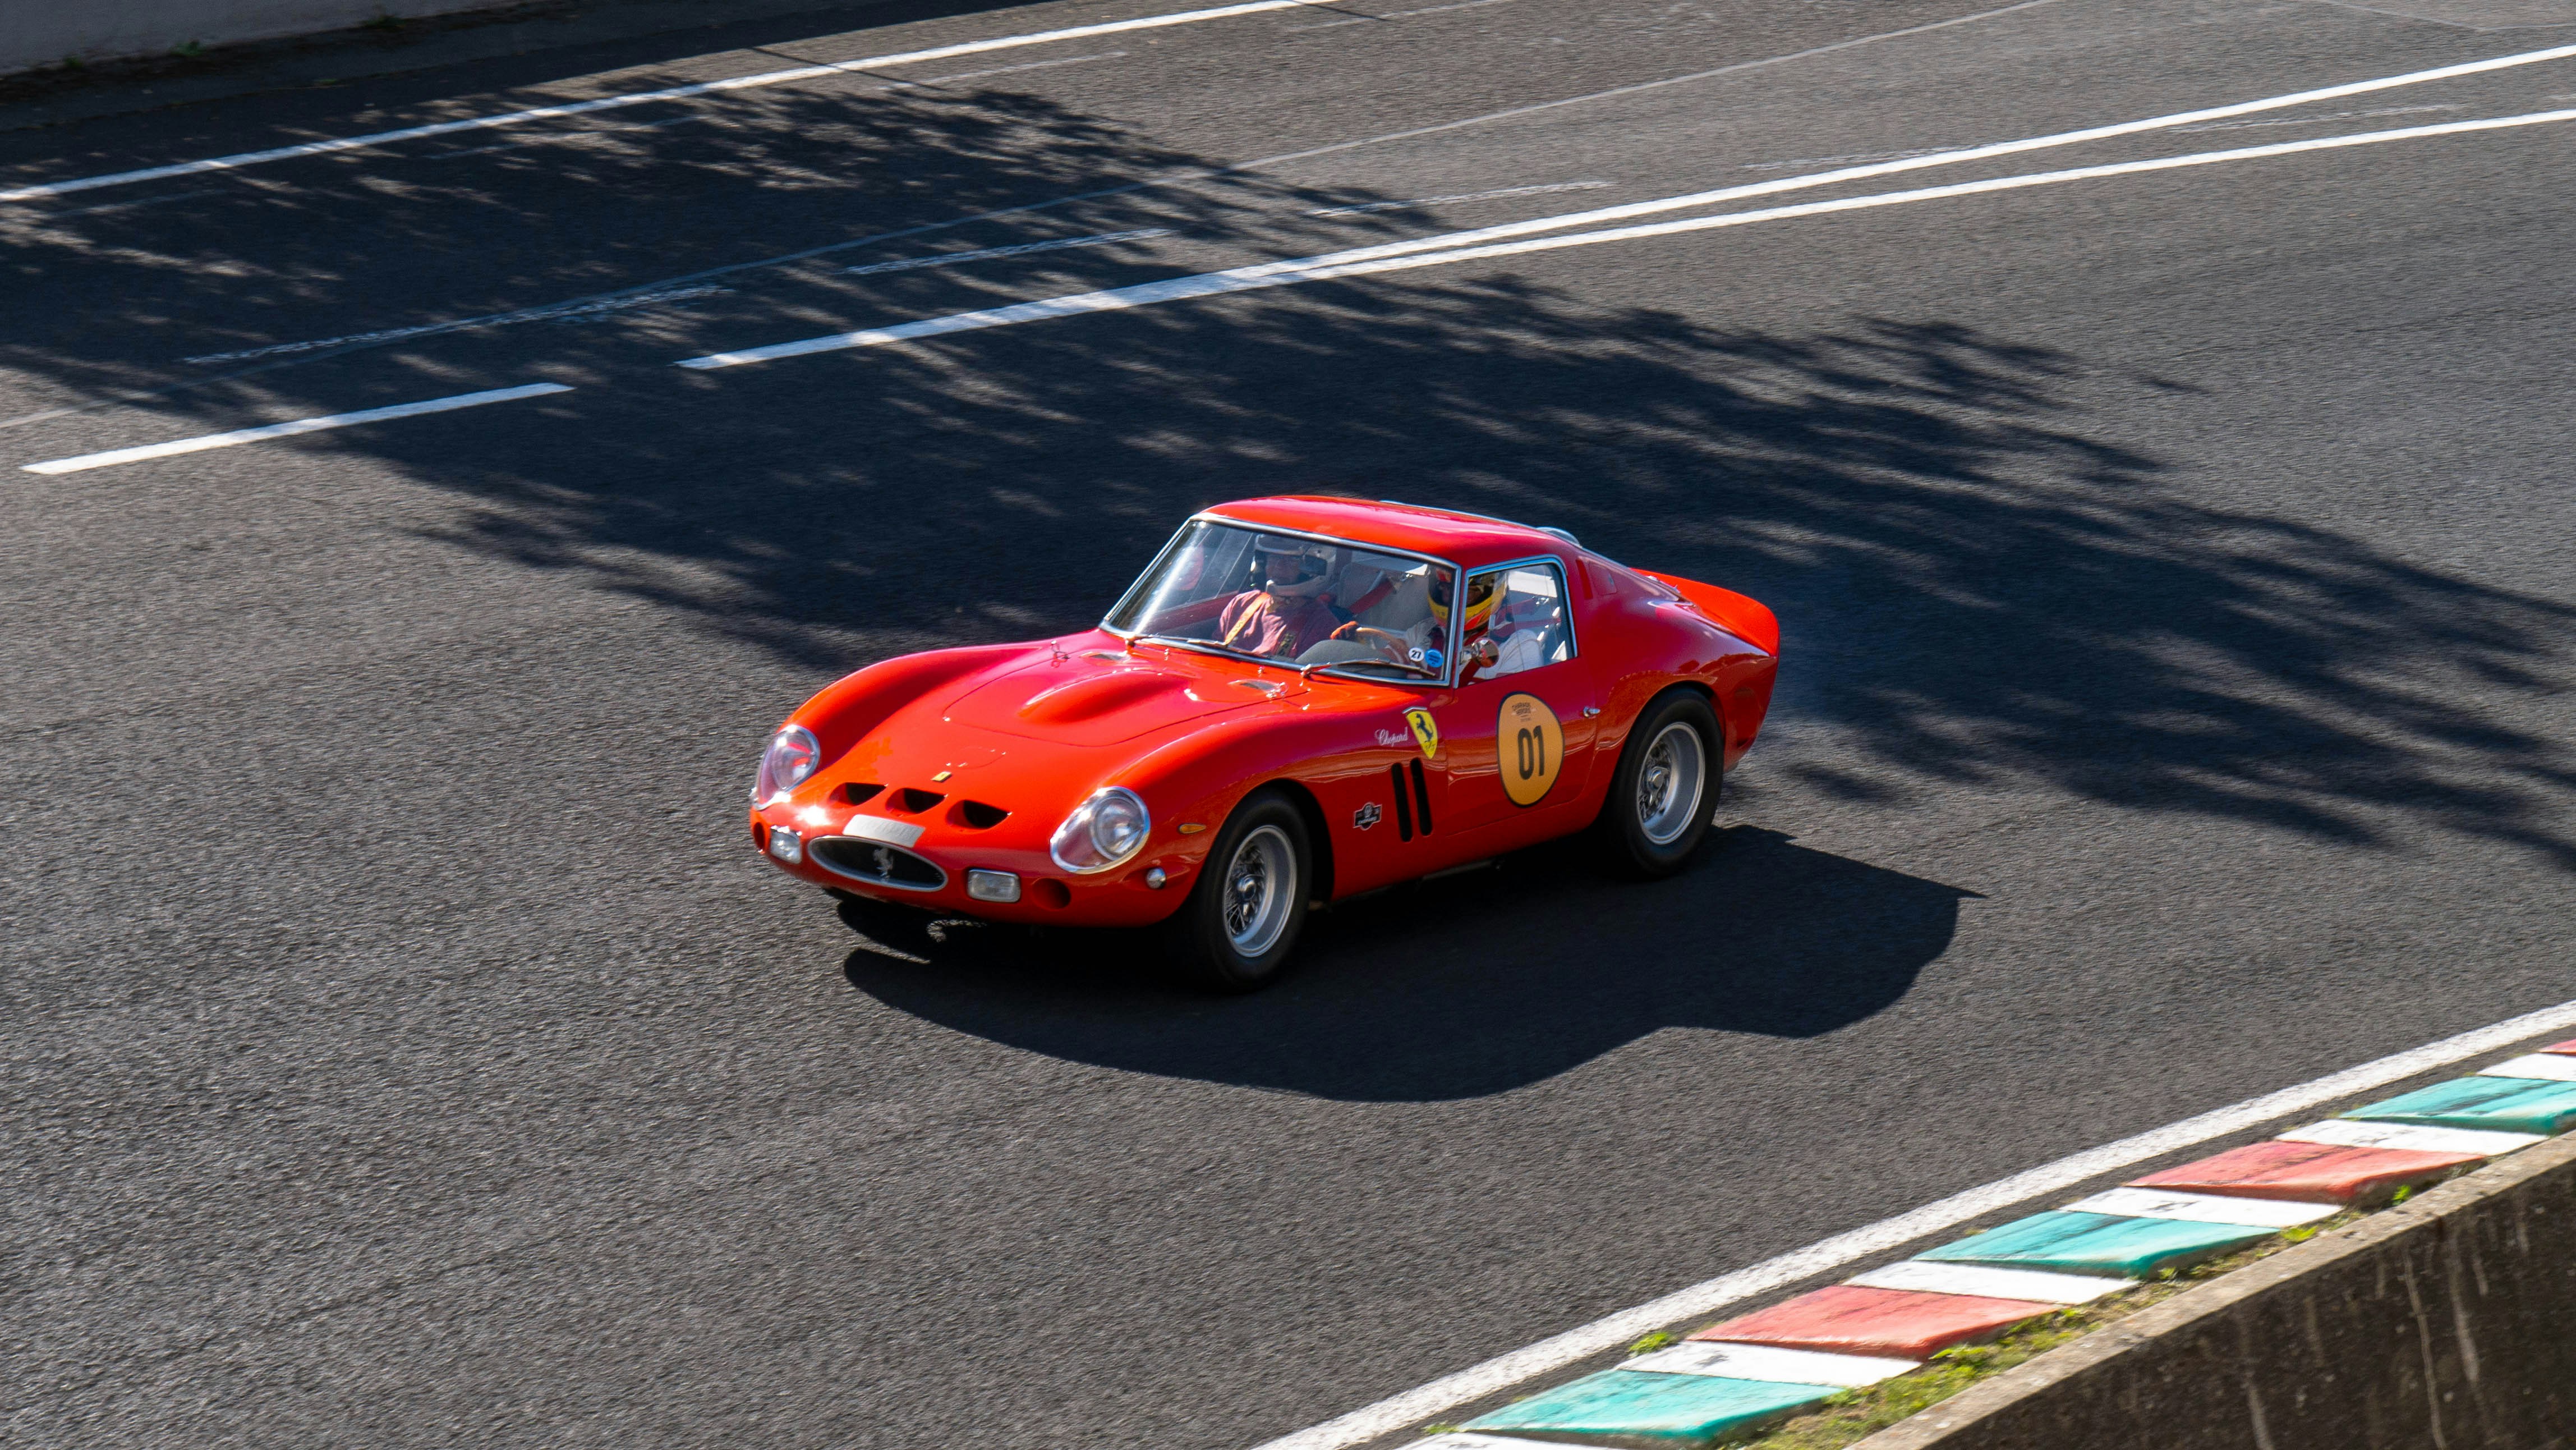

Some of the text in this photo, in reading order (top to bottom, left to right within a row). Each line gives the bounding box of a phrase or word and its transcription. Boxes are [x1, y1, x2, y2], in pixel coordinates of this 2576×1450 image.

[1411, 650, 1422, 659] 27
[1374, 726, 1409, 747] Chopard
[1517, 725, 1545, 780] 01
